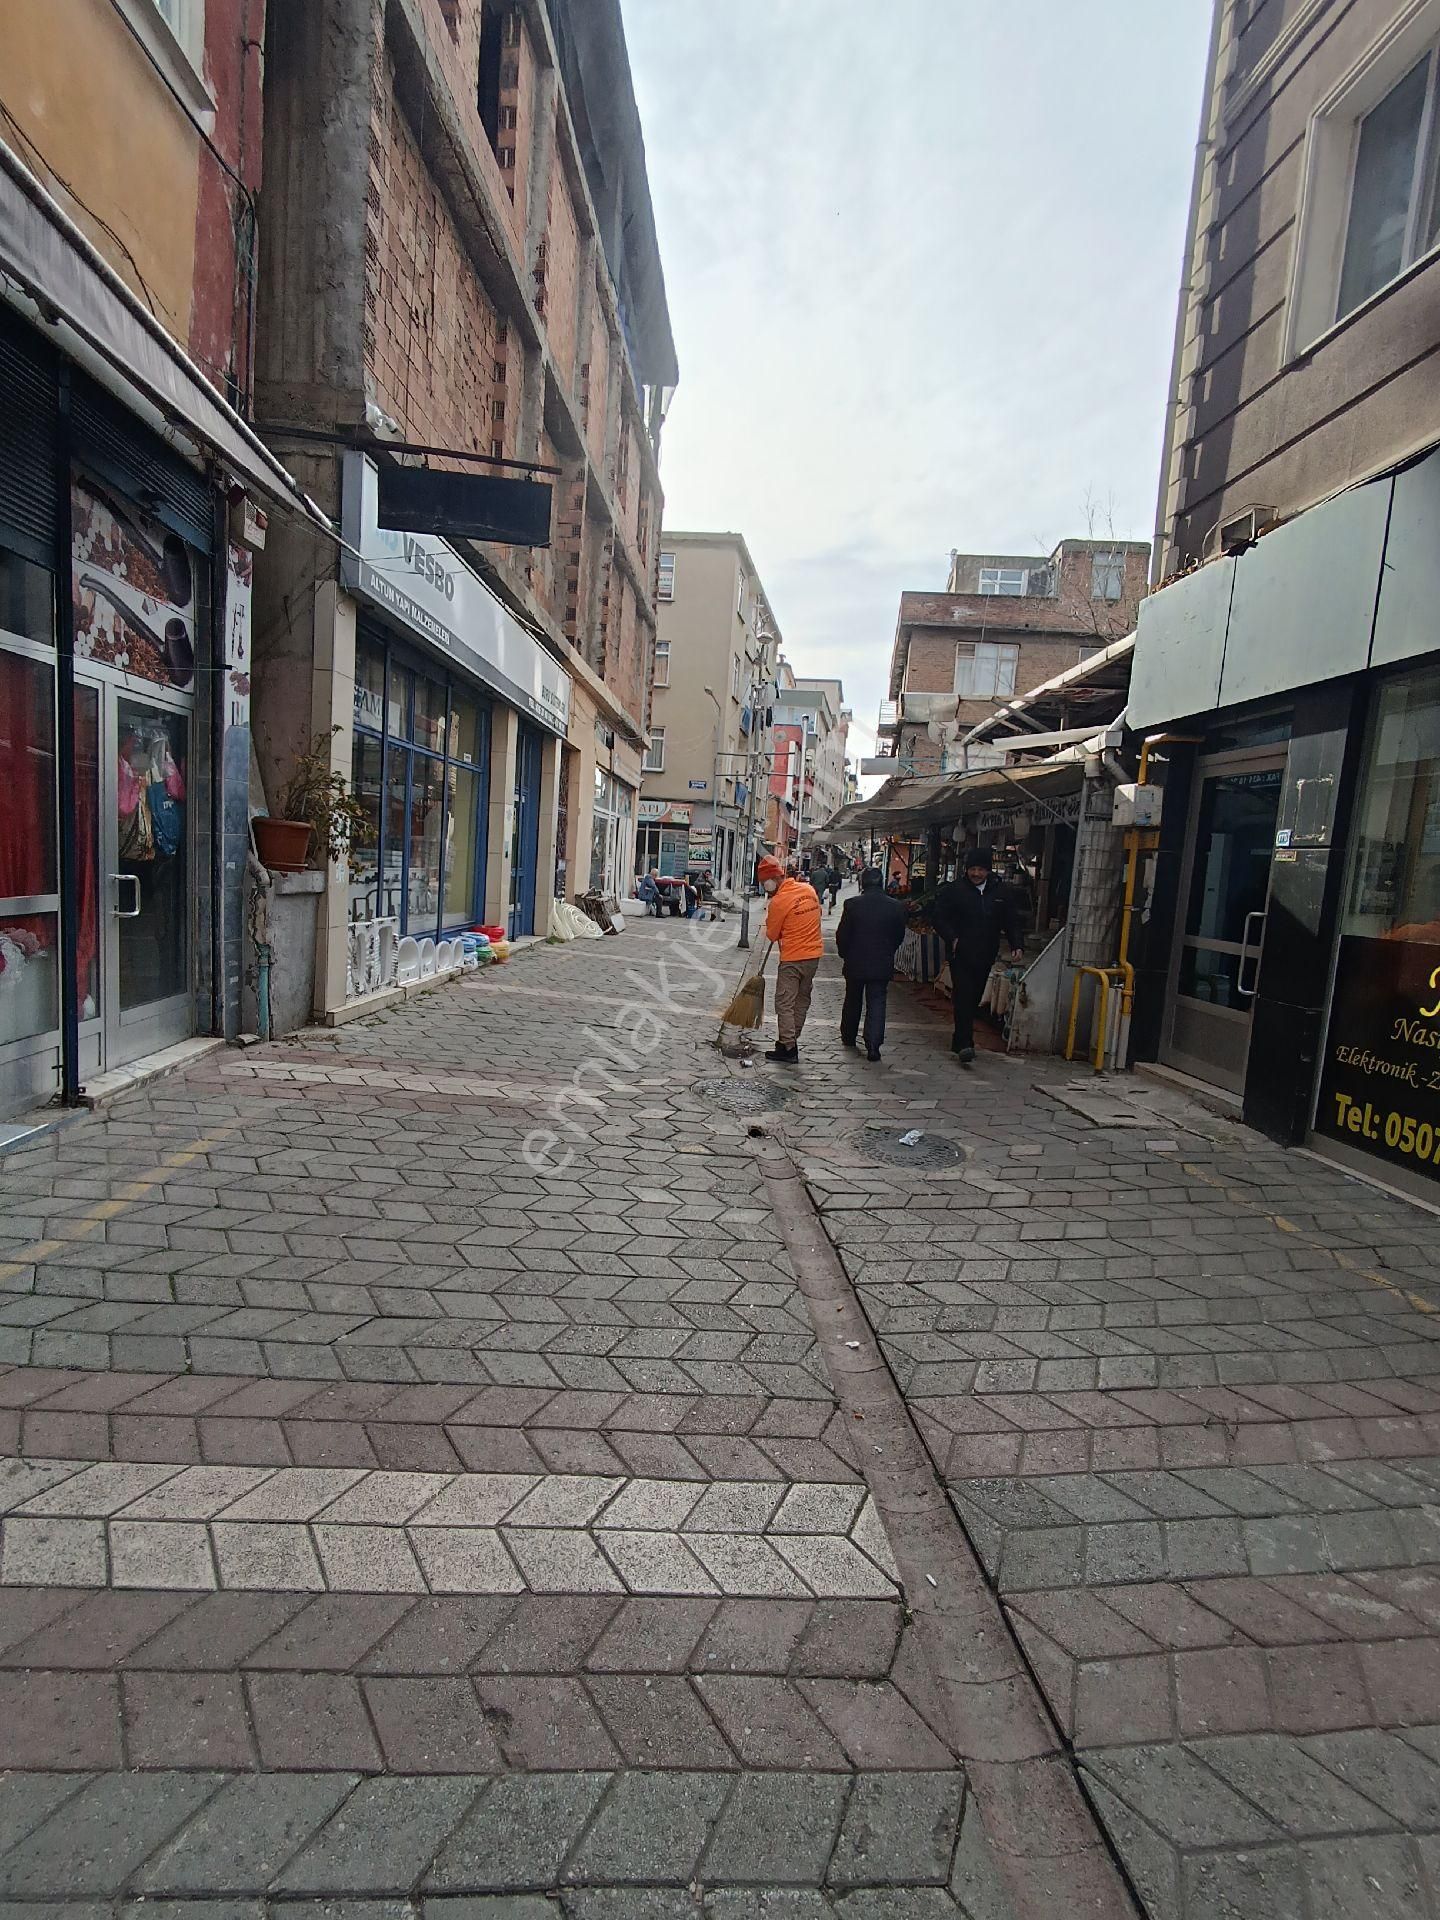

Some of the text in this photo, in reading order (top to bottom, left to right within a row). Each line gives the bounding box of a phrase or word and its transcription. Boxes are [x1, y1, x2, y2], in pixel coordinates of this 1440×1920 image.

[403, 532, 455, 601] VESBO
[1336, 1045, 1419, 1088] Elektronik
[1335, 1092, 1379, 1139] Tel:
